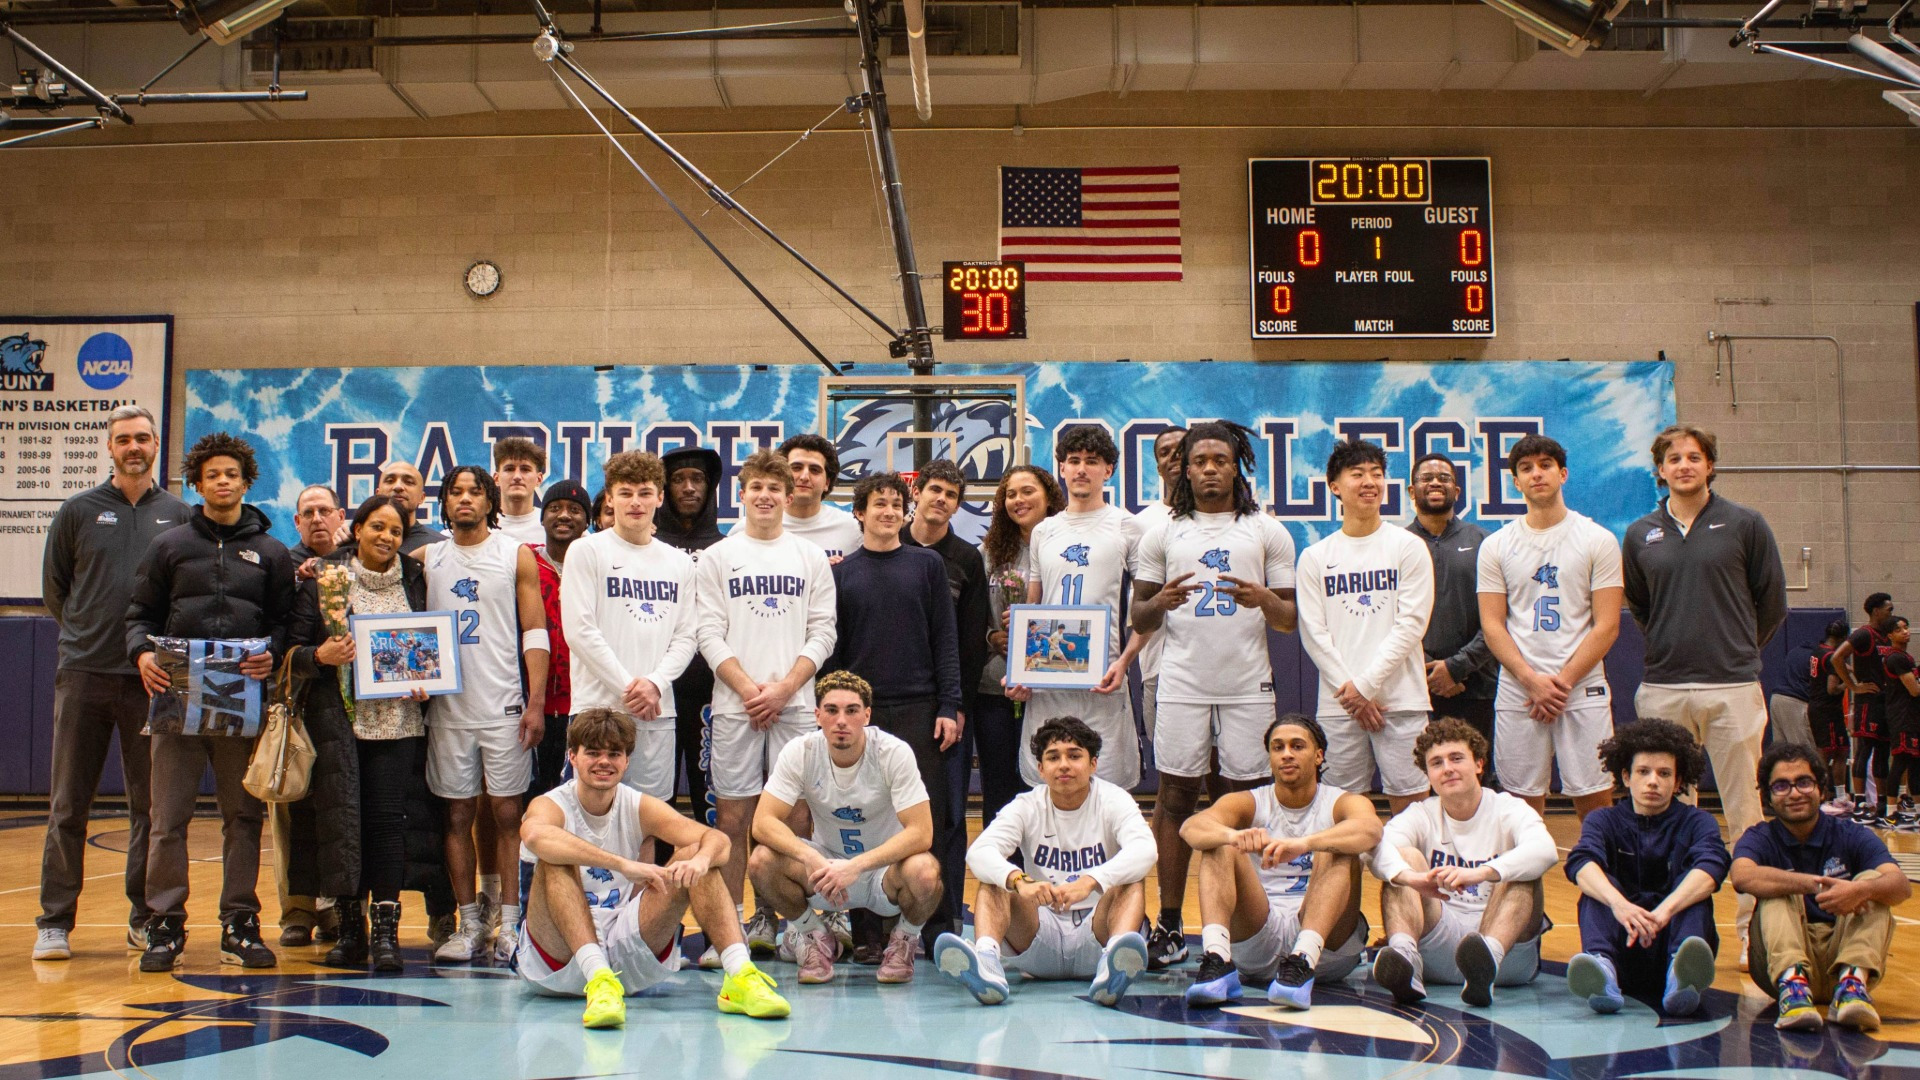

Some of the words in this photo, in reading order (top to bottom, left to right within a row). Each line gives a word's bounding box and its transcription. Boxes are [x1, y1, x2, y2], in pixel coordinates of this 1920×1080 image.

[1318, 164, 1424, 198] 20:00
[1266, 207, 1316, 225] HOME
[1351, 217, 1393, 229] PERIOD
[1424, 206, 1479, 224] GUEST
[1300, 230, 1320, 265] 0
[1375, 236, 1381, 260] 1
[1461, 230, 1482, 265] 0
[950, 267, 1018, 291] 20:00
[1258, 271, 1295, 283] FOULS
[1335, 271, 1378, 283] PLAYER
[1384, 271, 1414, 283] FOUL
[1450, 270, 1488, 282] FOULS
[1274, 286, 1290, 313] 0
[1467, 285, 1483, 312] 0
[963, 292, 1008, 332] 30
[1259, 320, 1297, 332] SCORE
[1354, 320, 1394, 332] MATCH
[1452, 319, 1490, 331] SCORE
[82, 360, 131, 376] NCAA
[0, 374, 46, 390] UNY
[0, 400, 28, 411] N'S
[18, 421, 70, 430] DIVISION
[19, 436, 52, 444] 1981-82
[64, 436, 98, 444] 1992-93
[18, 451, 51, 459] 1998-99
[63, 451, 98, 459] 1999-00
[17, 466, 51, 474] 2005-06
[62, 465, 97, 474] 2007-08
[1053, 417, 1543, 522] COLEGE
[16, 480, 50, 489] 2009-10
[62, 480, 96, 489] 2010-11
[36, 525, 41, 533] &
[607, 577, 678, 603] BARUCH
[729, 574, 806, 598] BARUCH
[1061, 574, 1083, 605] 11
[1324, 569, 1398, 597] BARUCH
[1194, 580, 1237, 617] 25
[1533, 596, 1560, 631] 15
[455, 609, 480, 645] 2
[840, 828, 865, 855] 5
[1034, 842, 1107, 873] BARUCH
